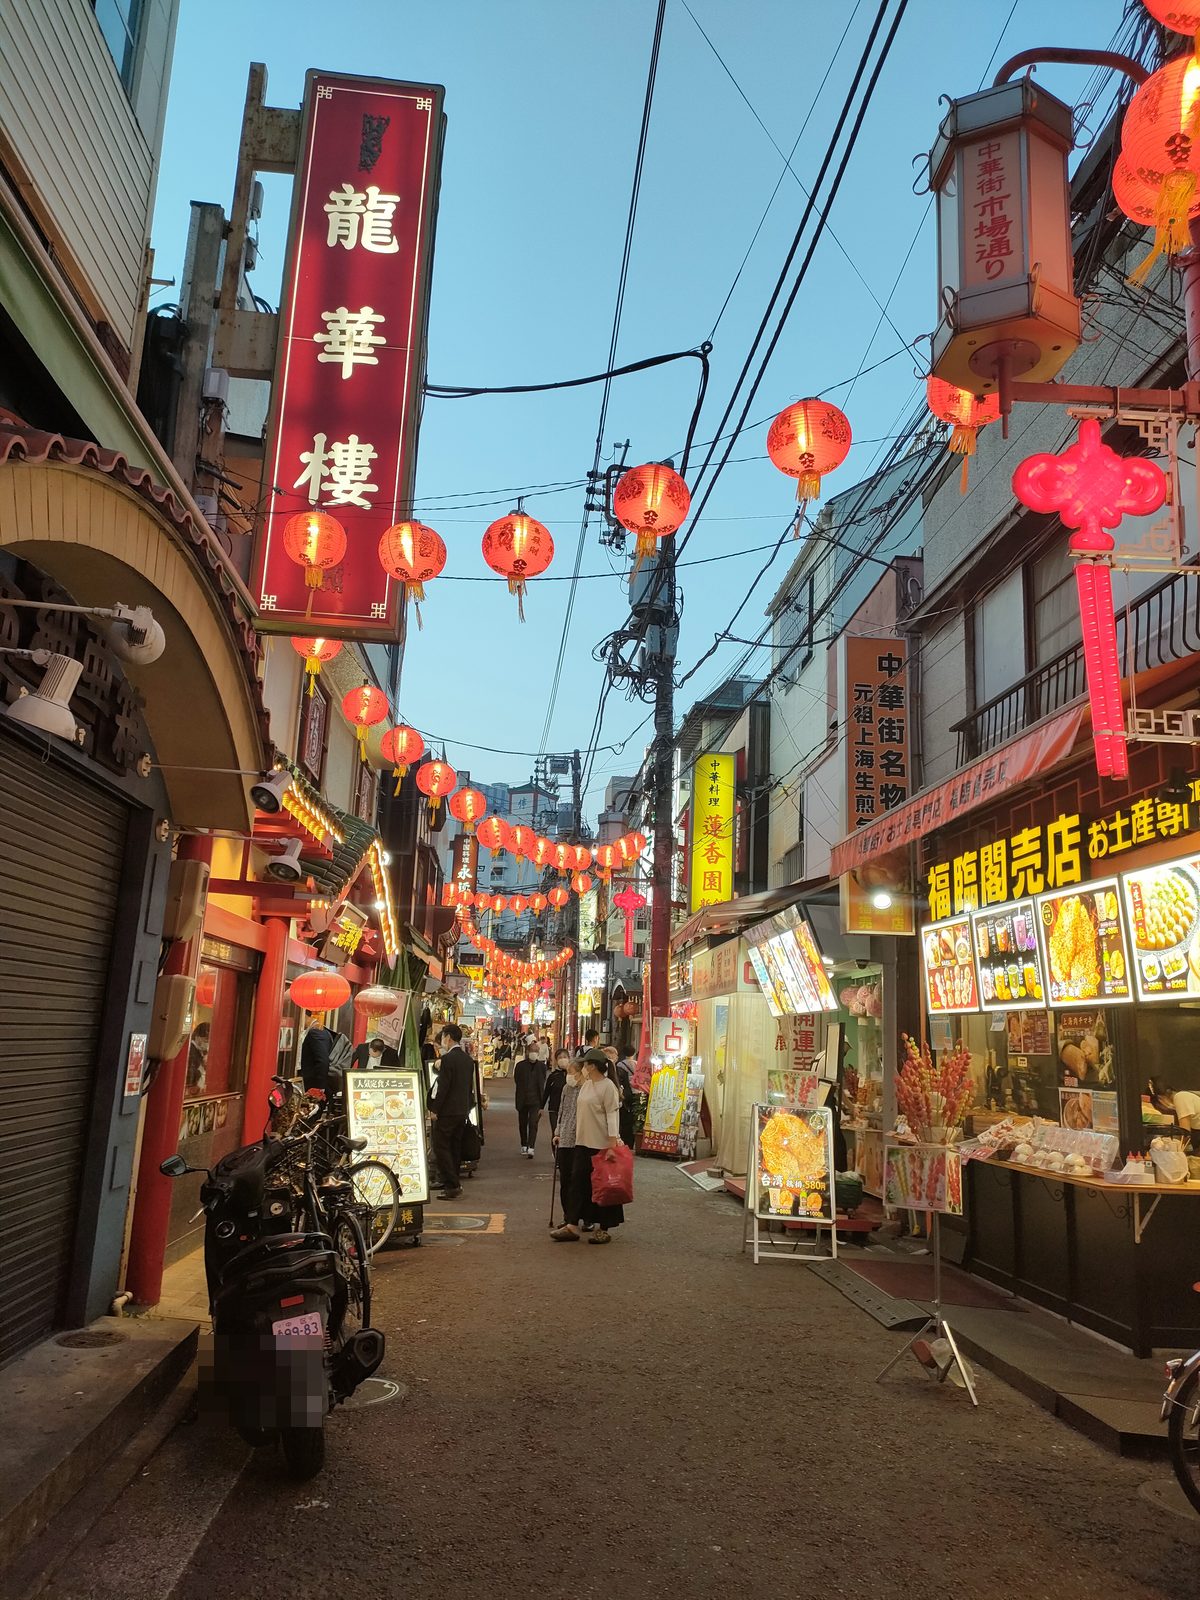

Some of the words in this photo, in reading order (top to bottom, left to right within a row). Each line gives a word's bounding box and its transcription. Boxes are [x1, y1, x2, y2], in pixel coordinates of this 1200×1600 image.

[973, 143, 1014, 280] 中華街市場通り
[293, 184, 400, 509] 龍華樓
[877, 652, 906, 812] 中華街名物
[708, 760, 721, 807] 中華料理
[702, 814, 726, 893] 蓮香園
[927, 813, 1082, 922] 福臨閣売店
[664, 1021, 682, 1052] 占
[356, 1079, 412, 1089] 人気定食メニュー
[761, 1173, 783, 1188] 台湾
